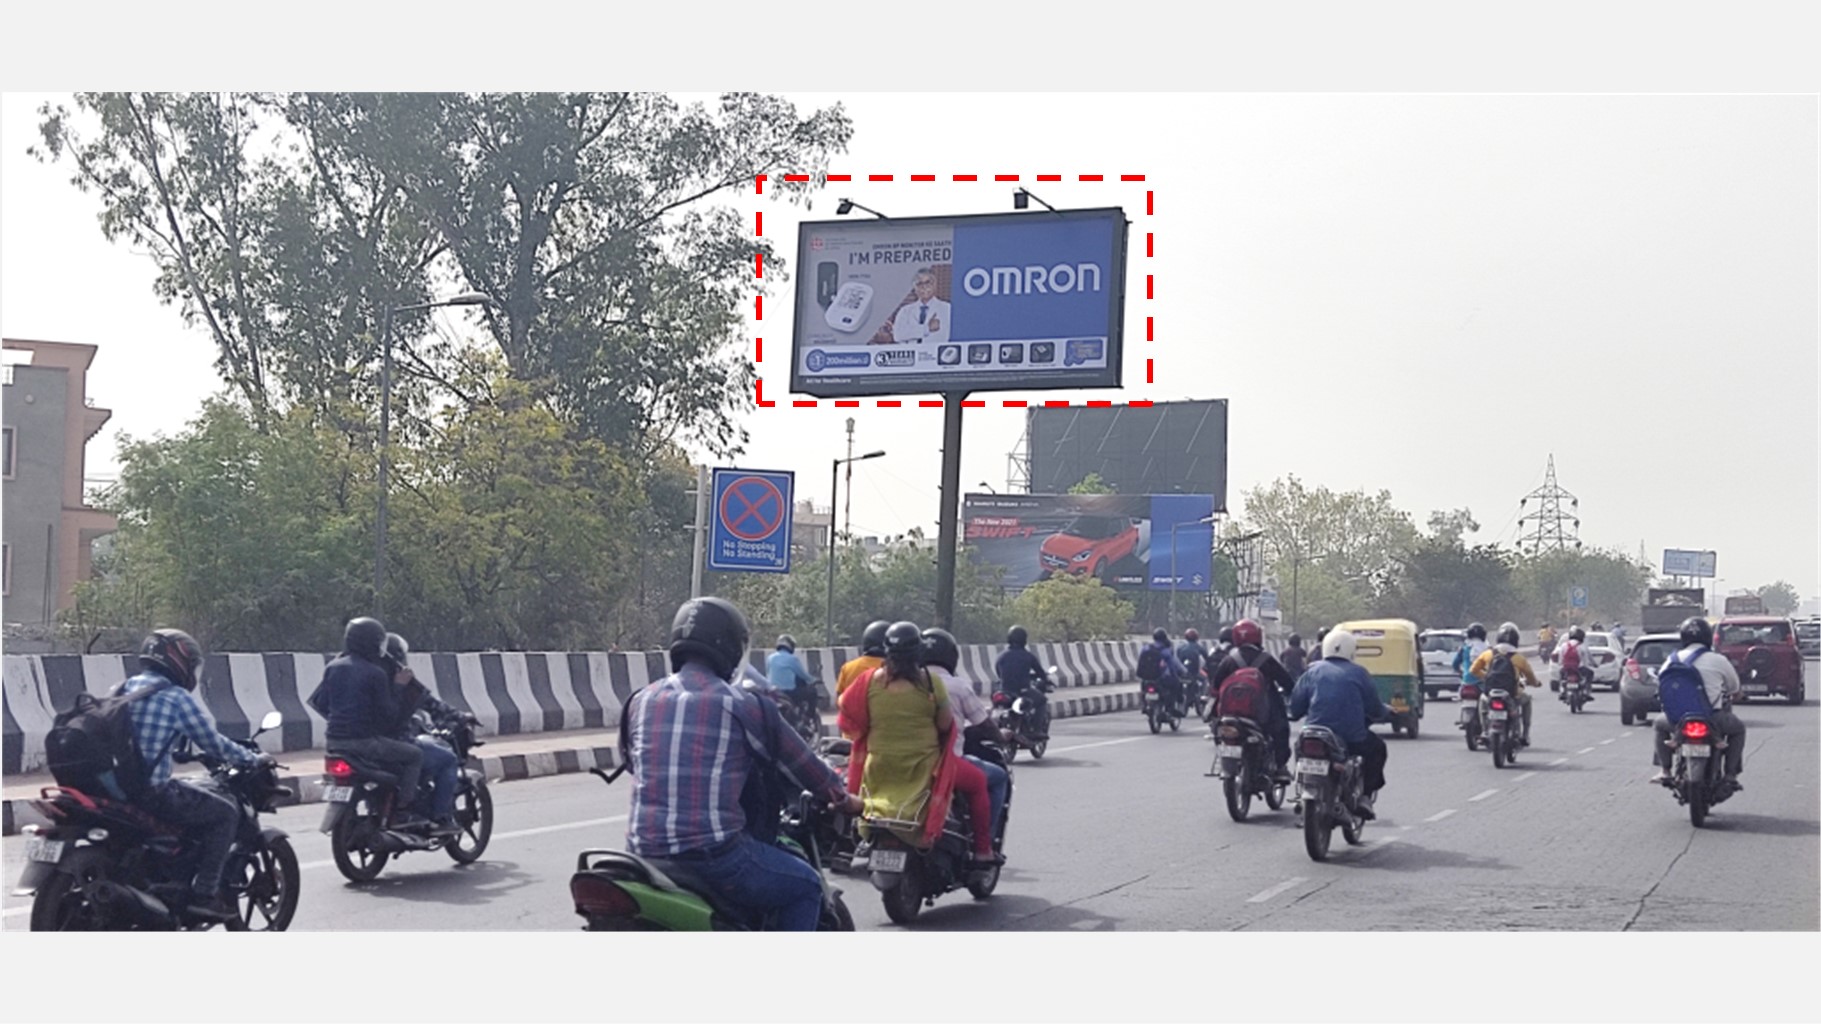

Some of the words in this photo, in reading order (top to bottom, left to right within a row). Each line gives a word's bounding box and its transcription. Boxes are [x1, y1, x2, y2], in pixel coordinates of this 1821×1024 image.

[849, 252, 870, 265] I'M
[874, 248, 952, 264] PREPARED
[963, 263, 1101, 297] OMRON
[966, 525, 1036, 539] SWIFT
[723, 540, 735, 549] No
[737, 540, 776, 552] Stopping
[723, 549, 735, 558] No
[737, 549, 776, 561] Standing
